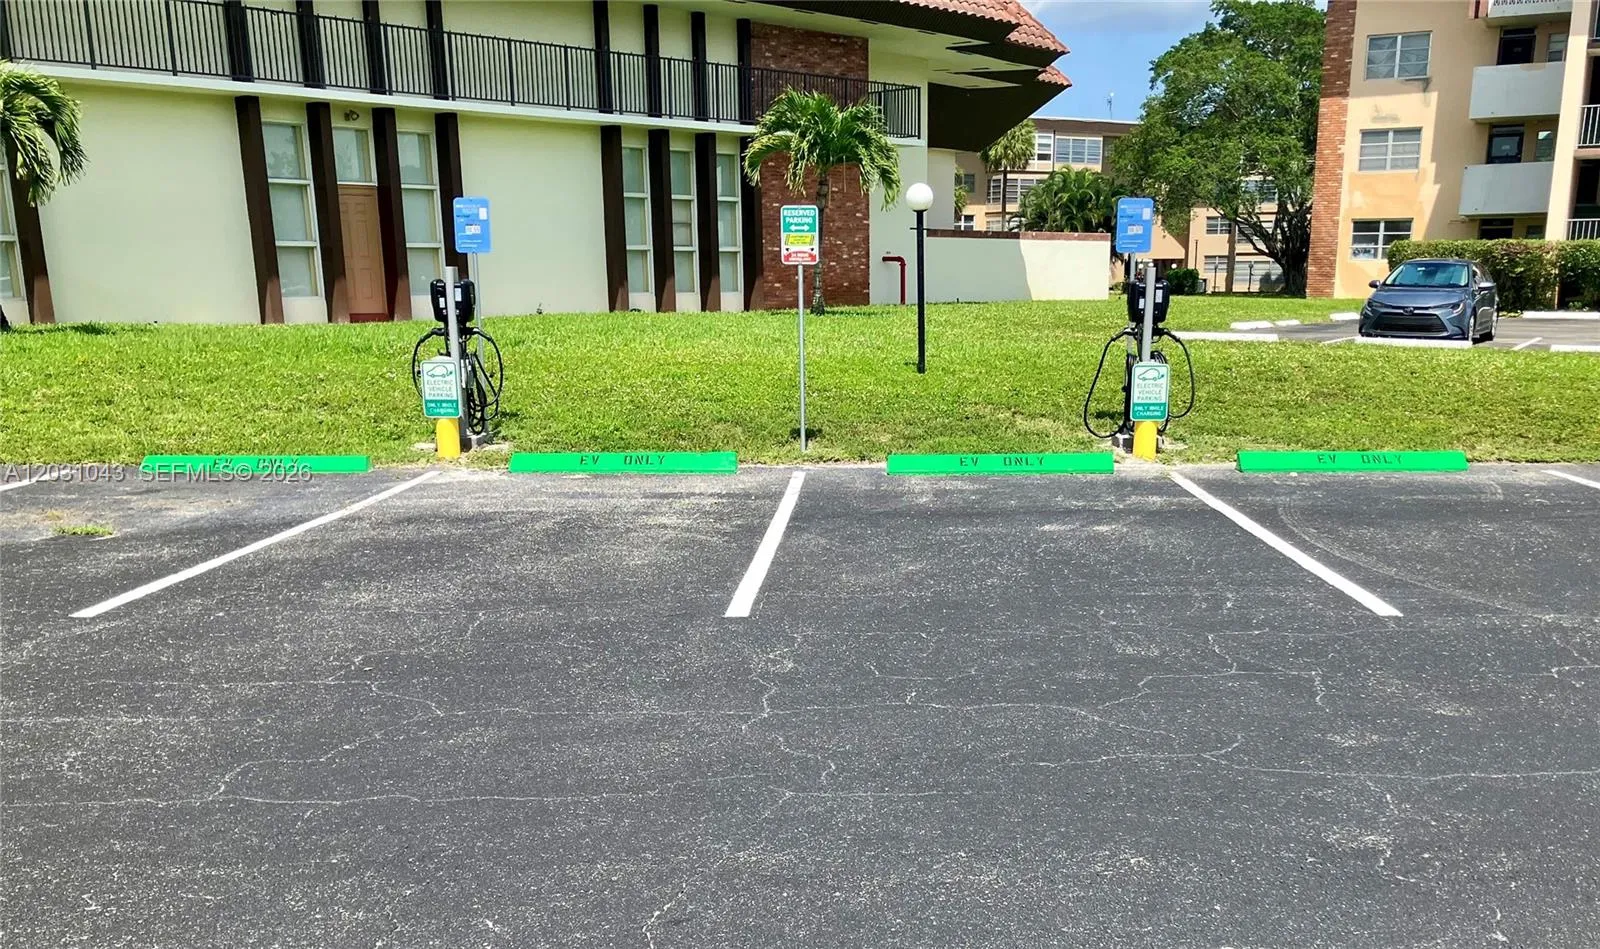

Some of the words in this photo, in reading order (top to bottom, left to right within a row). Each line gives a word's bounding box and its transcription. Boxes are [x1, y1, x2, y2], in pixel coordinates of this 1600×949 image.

[580, 455, 600, 465] EV
[624, 455, 665, 465] ONLY
[960, 456, 978, 467] EV
[1004, 456, 1044, 466] ONLY
[1317, 454, 1336, 464] EV
[1361, 454, 1402, 464] ONLY
